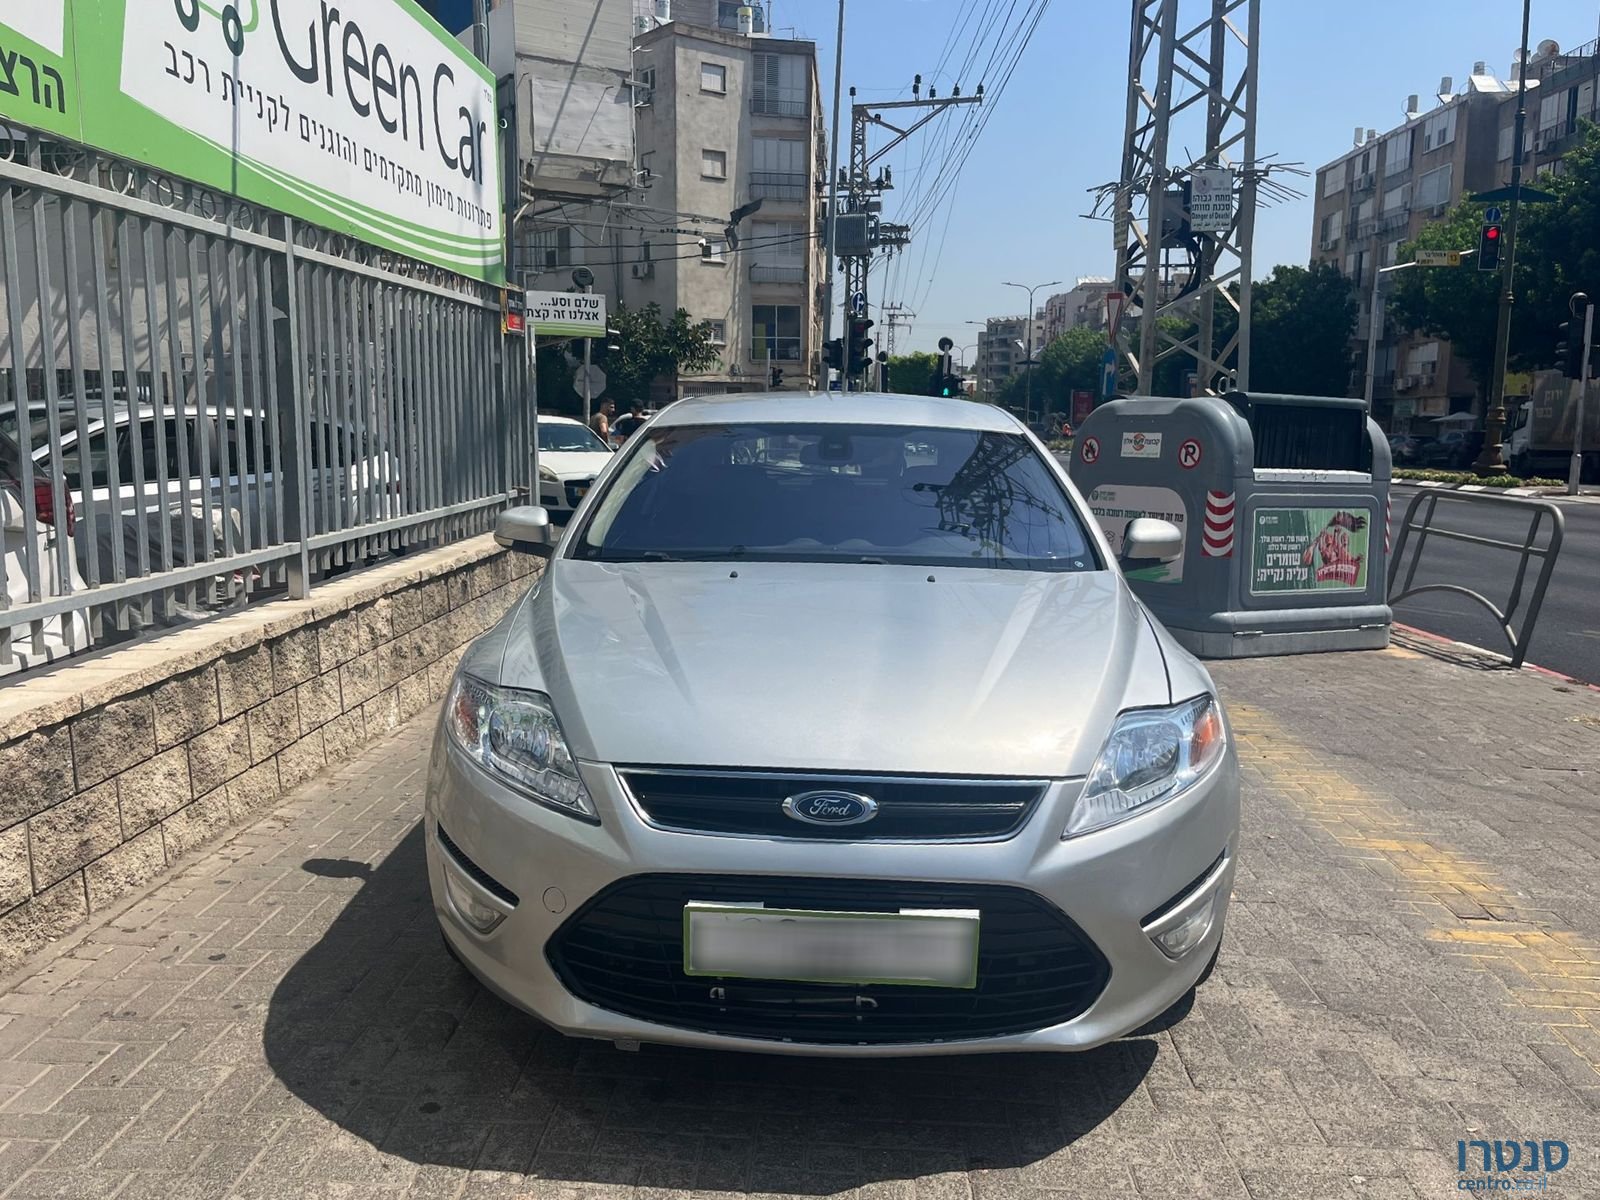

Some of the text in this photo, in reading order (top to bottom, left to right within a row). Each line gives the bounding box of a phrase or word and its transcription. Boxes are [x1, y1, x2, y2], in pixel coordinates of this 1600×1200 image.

[433, 63, 486, 185] Car
[164, 41, 492, 229] פתרונות מימון מתקדמים והוגנים לקניית רכב
[1215, 194, 1231, 202] מתח
[1212, 203, 1231, 211] סכנת
[1191, 212, 1208, 221] Danger
[540, 296, 599, 309] שלם וסע...
[526, 307, 600, 321] אצלנו זה קצת
[1105, 508, 1124, 517] רטובה
[1124, 509, 1146, 519] לאשפה
[1165, 512, 1174, 522] זה
[1174, 513, 1184, 523] פח
[1266, 553, 1301, 566] שומרים
[1257, 568, 1285, 584] נקייה!
[1286, 566, 1308, 581] עליה
[809, 797, 851, 816] Ford
